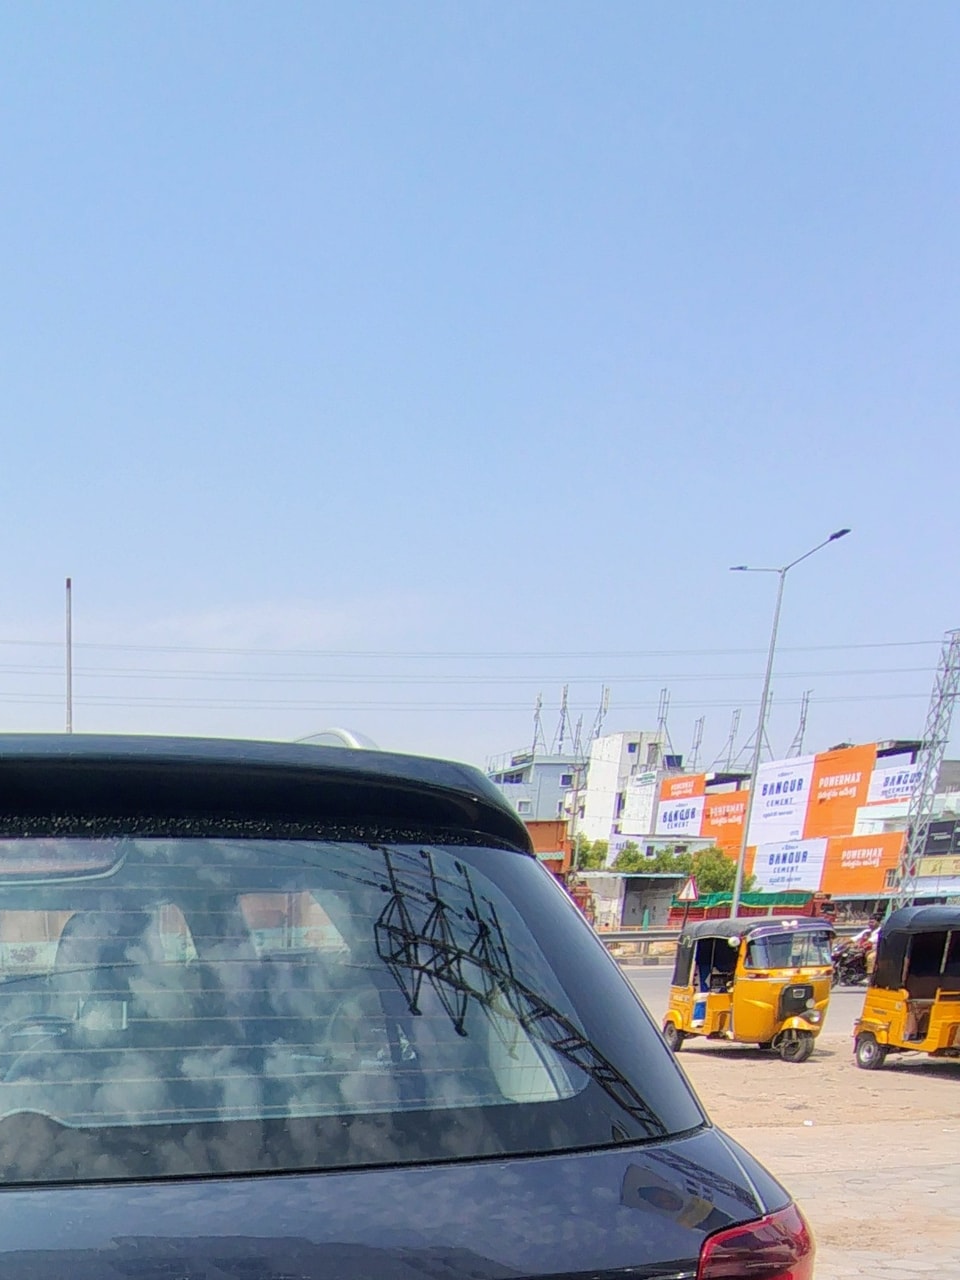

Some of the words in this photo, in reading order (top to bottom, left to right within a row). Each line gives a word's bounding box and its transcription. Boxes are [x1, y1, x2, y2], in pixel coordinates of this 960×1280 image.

[819, 772, 862, 788] POWERMAX
[762, 778, 803, 796] BANGUR
[766, 797, 793, 807] CEMENT
[768, 851, 808, 865] BANGUR
[841, 848, 883, 860] POWERMAX
[773, 866, 798, 874] CEMENT
